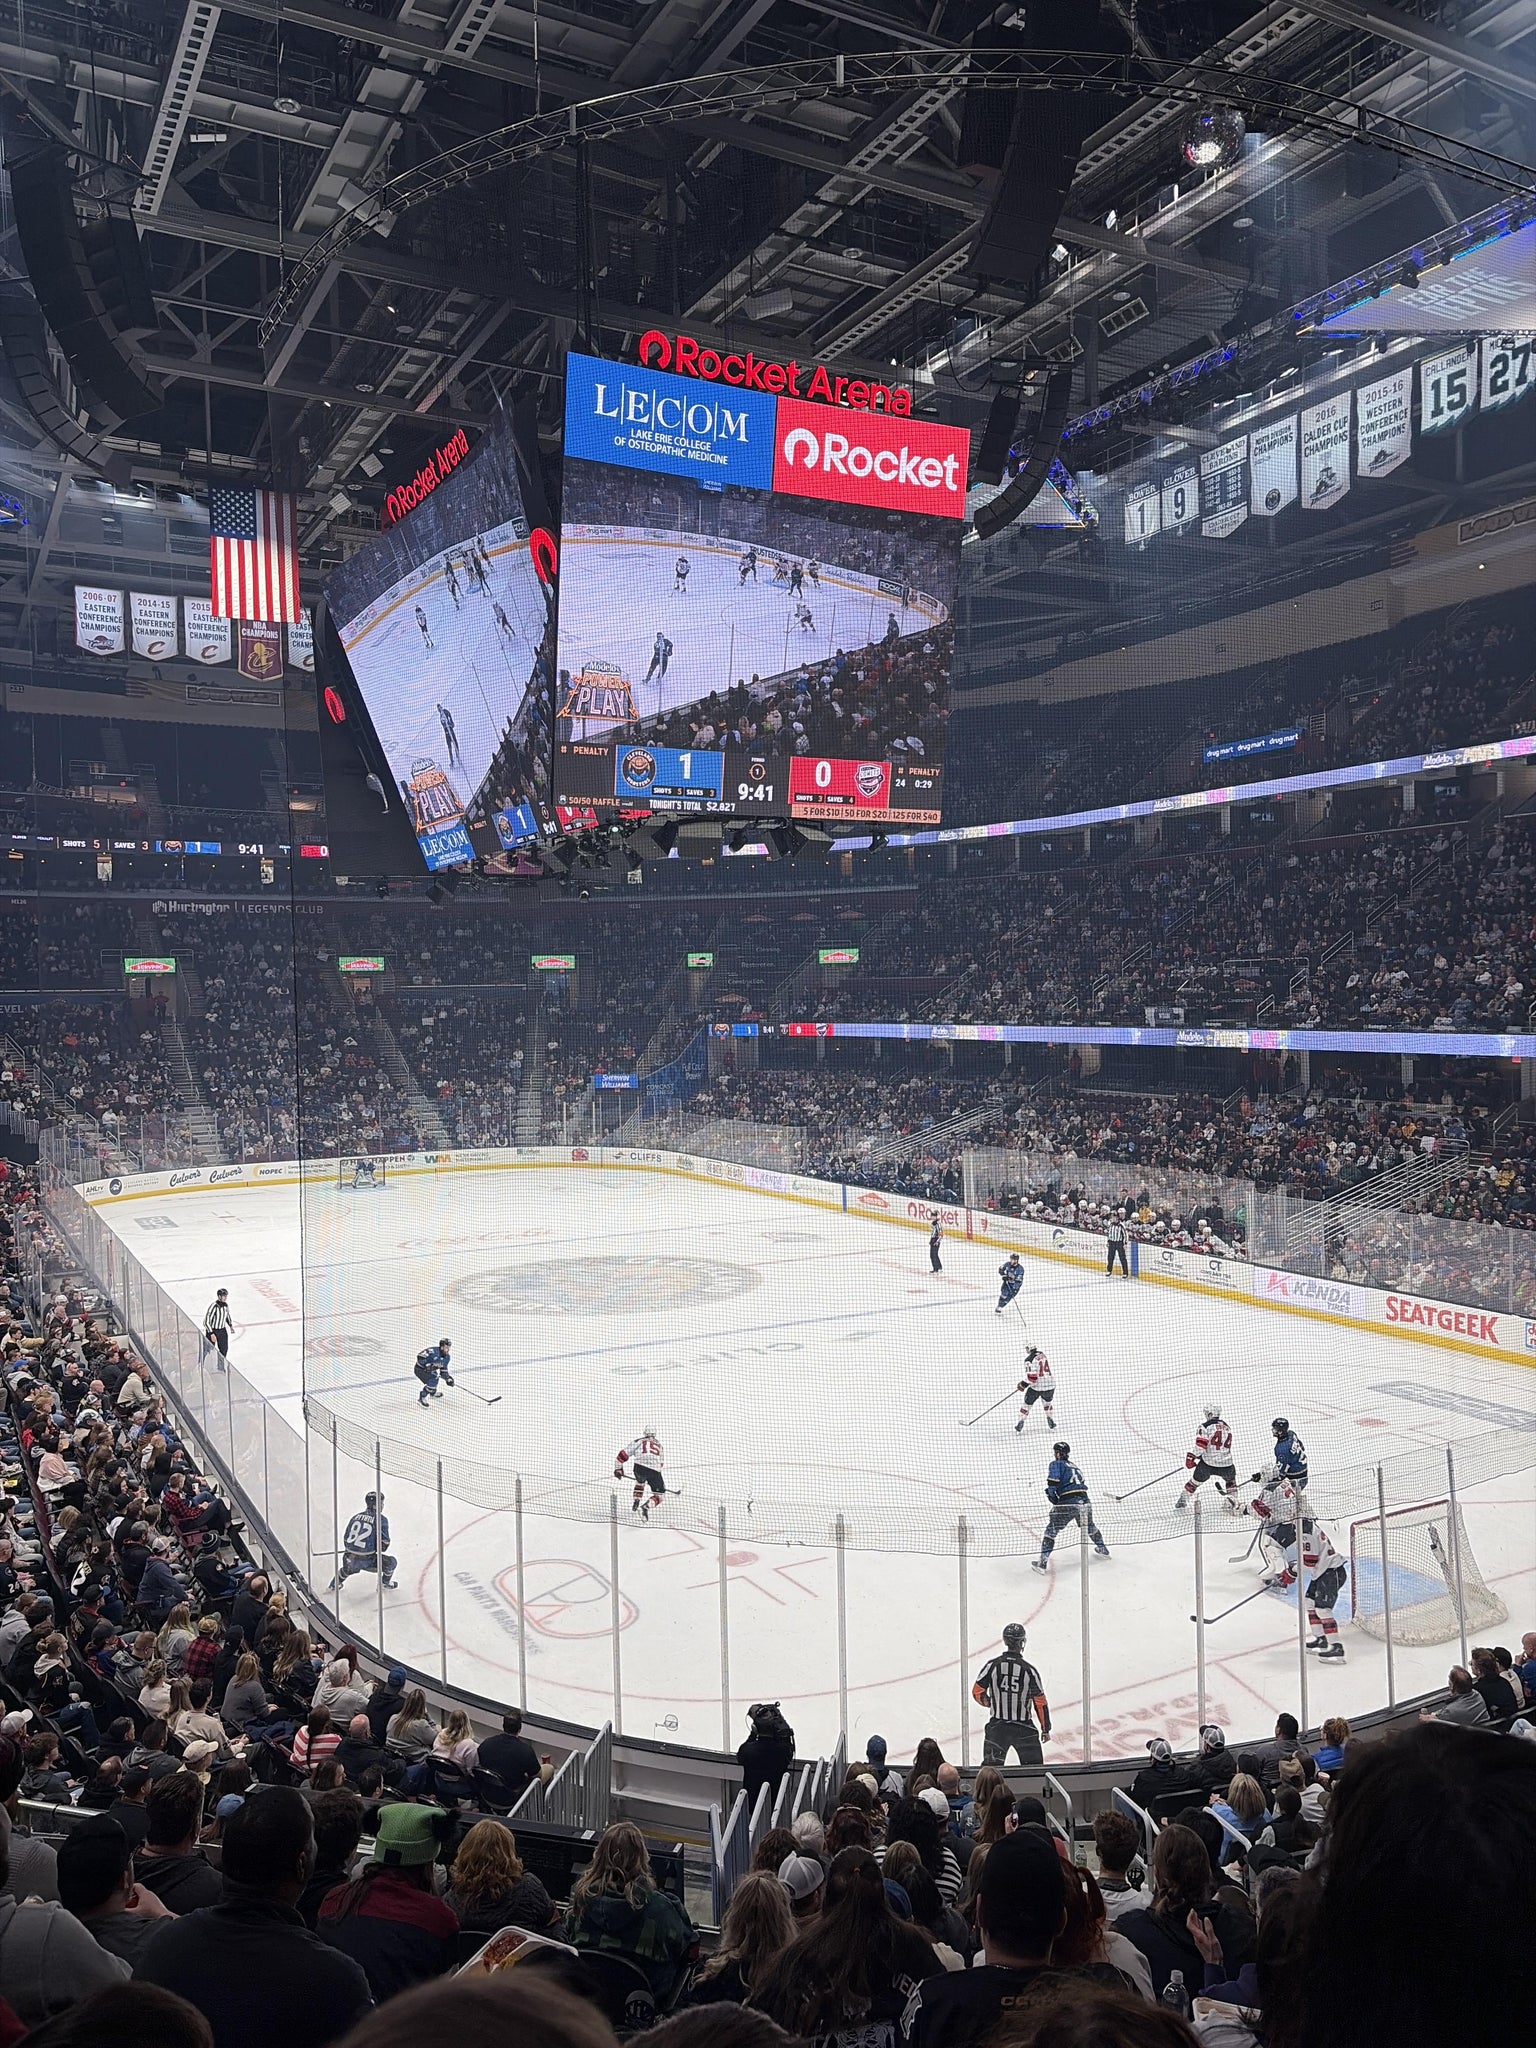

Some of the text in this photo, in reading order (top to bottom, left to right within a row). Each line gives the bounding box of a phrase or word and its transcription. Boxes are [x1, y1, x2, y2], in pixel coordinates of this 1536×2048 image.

[1425, 352, 1472, 377] CALLANDER
[1489, 343, 1532, 396] 27
[675, 335, 911, 416] Rocket Arena
[1365, 380, 1404, 405] 2015-16
[1430, 367, 1468, 419] 15
[1315, 405, 1336, 423] 2016
[1366, 397, 1403, 419] WESTERN
[1360, 408, 1409, 435] CONFERENCE
[1270, 425, 1291, 439] DIVISION
[1304, 416, 1348, 444] CALDER CUP
[1361, 423, 1406, 448] CHAMPIONS
[631, 428, 711, 451] LAKE ERIE COLLEGE
[1253, 433, 1294, 456] CHAMPIONS
[1304, 430, 1348, 458] CHAMPIONS
[614, 436, 728, 464] OF OSTEOPATHIC MEDICINE
[823, 432, 960, 491] Rocket
[396, 428, 470, 515] Rocket Arena
[1163, 467, 1196, 487] GLOVER
[1128, 485, 1156, 501] BOWER
[1174, 487, 1186, 520] 9
[1138, 502, 1146, 536] 1
[83, 592, 117, 603] 2006-07
[138, 598, 170, 609] 2014-15
[85, 603, 116, 613] EASTERN
[191, 602, 210, 611] 2015
[79, 612, 123, 624] CONFERENCE
[140, 610, 169, 619] EASTERN
[193, 614, 222, 623] EASTERN
[81, 622, 121, 633] CHAMPIONS
[134, 618, 176, 629] CONFERENCE
[188, 623, 228, 633] CONFERENCE
[252, 621, 267, 630] NBA
[296, 623, 311, 631] EAST
[136, 627, 174, 638] CHAMPIONS
[189, 632, 227, 642] CHAMPIONS
[241, 628, 278, 639] CHAMPIONS
[590, 661, 617, 673] Modelo
[581, 673, 624, 688] POWER
[575, 687, 626, 716] PLAY
[573, 746, 609, 756] PENALTY
[1206, 749, 1219, 757] drug
[1220, 747, 1233, 755] mart
[1250, 740, 1265, 749] mart
[1269, 737, 1283, 745] drug
[1283, 733, 1298, 742] mart
[679, 752, 692, 780] 1
[909, 767, 941, 776] PENALTY
[815, 760, 831, 787] 0
[895, 779, 932, 789] 24 0:29
[653, 787, 683, 796] SHOTS 5
[738, 783, 773, 802] 9:41
[796, 794, 813, 802] SHOTS
[419, 783, 456, 822] PLAY
[568, 796, 591, 805] 50/50
[593, 798, 621, 807] RAFFLE
[649, 799, 736, 812] TONIGHT'S TOTAL $2,827
[516, 808, 527, 829] 1
[803, 807, 808, 815] 5
[826, 808, 840, 817] $10
[845, 809, 854, 817] 50
[856, 810, 871, 818] FOR
[873, 810, 888, 819] $20
[893, 811, 905, 819] 125
[907, 811, 922, 820] FOR
[923, 812, 938, 821] $40
[543, 822, 558, 835] 9:41
[62, 839, 100, 848] SHOTS 5
[141, 841, 149, 850] 3
[195, 842, 200, 853] 1
[238, 844, 264, 854] 9:41
[320, 845, 328, 856] 0
[168, 901, 230, 915] Huntington
[241, 904, 324, 914] LEGENDS CLUB
[762, 1026, 775, 1034] 9:41
[796, 1026, 802, 1034] 0
[1177, 1030, 1204, 1042] Modelo
[1213, 1031, 1249, 1048] POWER
[425, 1154, 452, 1163] WM
[630, 1152, 662, 1162] CLIFFS
[169, 1169, 202, 1187] Culver's
[209, 1166, 243, 1184] Culver's
[259, 1168, 283, 1176] NOPEC
[1294, 1281, 1351, 1306] KENDA
[1328, 1303, 1351, 1314] TIRES
[1386, 1295, 1500, 1345] SEATGEEK
[1039, 1361, 1052, 1377] 14
[1211, 1430, 1232, 1450] 44
[642, 1440, 661, 1456] 15
[346, 1521, 373, 1548] 82
[454, 1572, 501, 1610] CAR PARTS
[1000, 1675, 1019, 1693] 45
